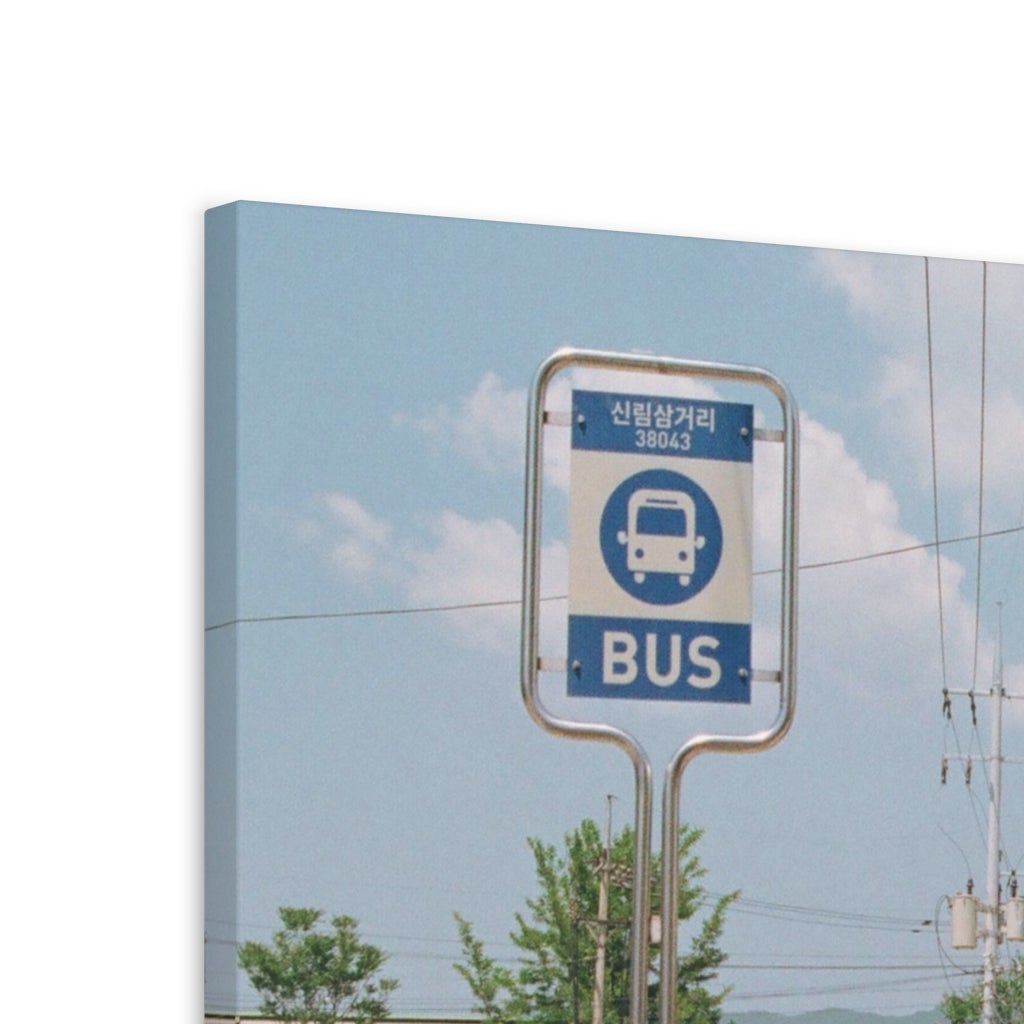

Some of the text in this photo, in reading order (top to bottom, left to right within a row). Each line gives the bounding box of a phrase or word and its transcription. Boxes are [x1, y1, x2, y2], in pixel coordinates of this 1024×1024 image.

[610, 399, 716, 433] 신림삼거리
[635, 429, 691, 451] 38043
[602, 631, 722, 688] BUS
